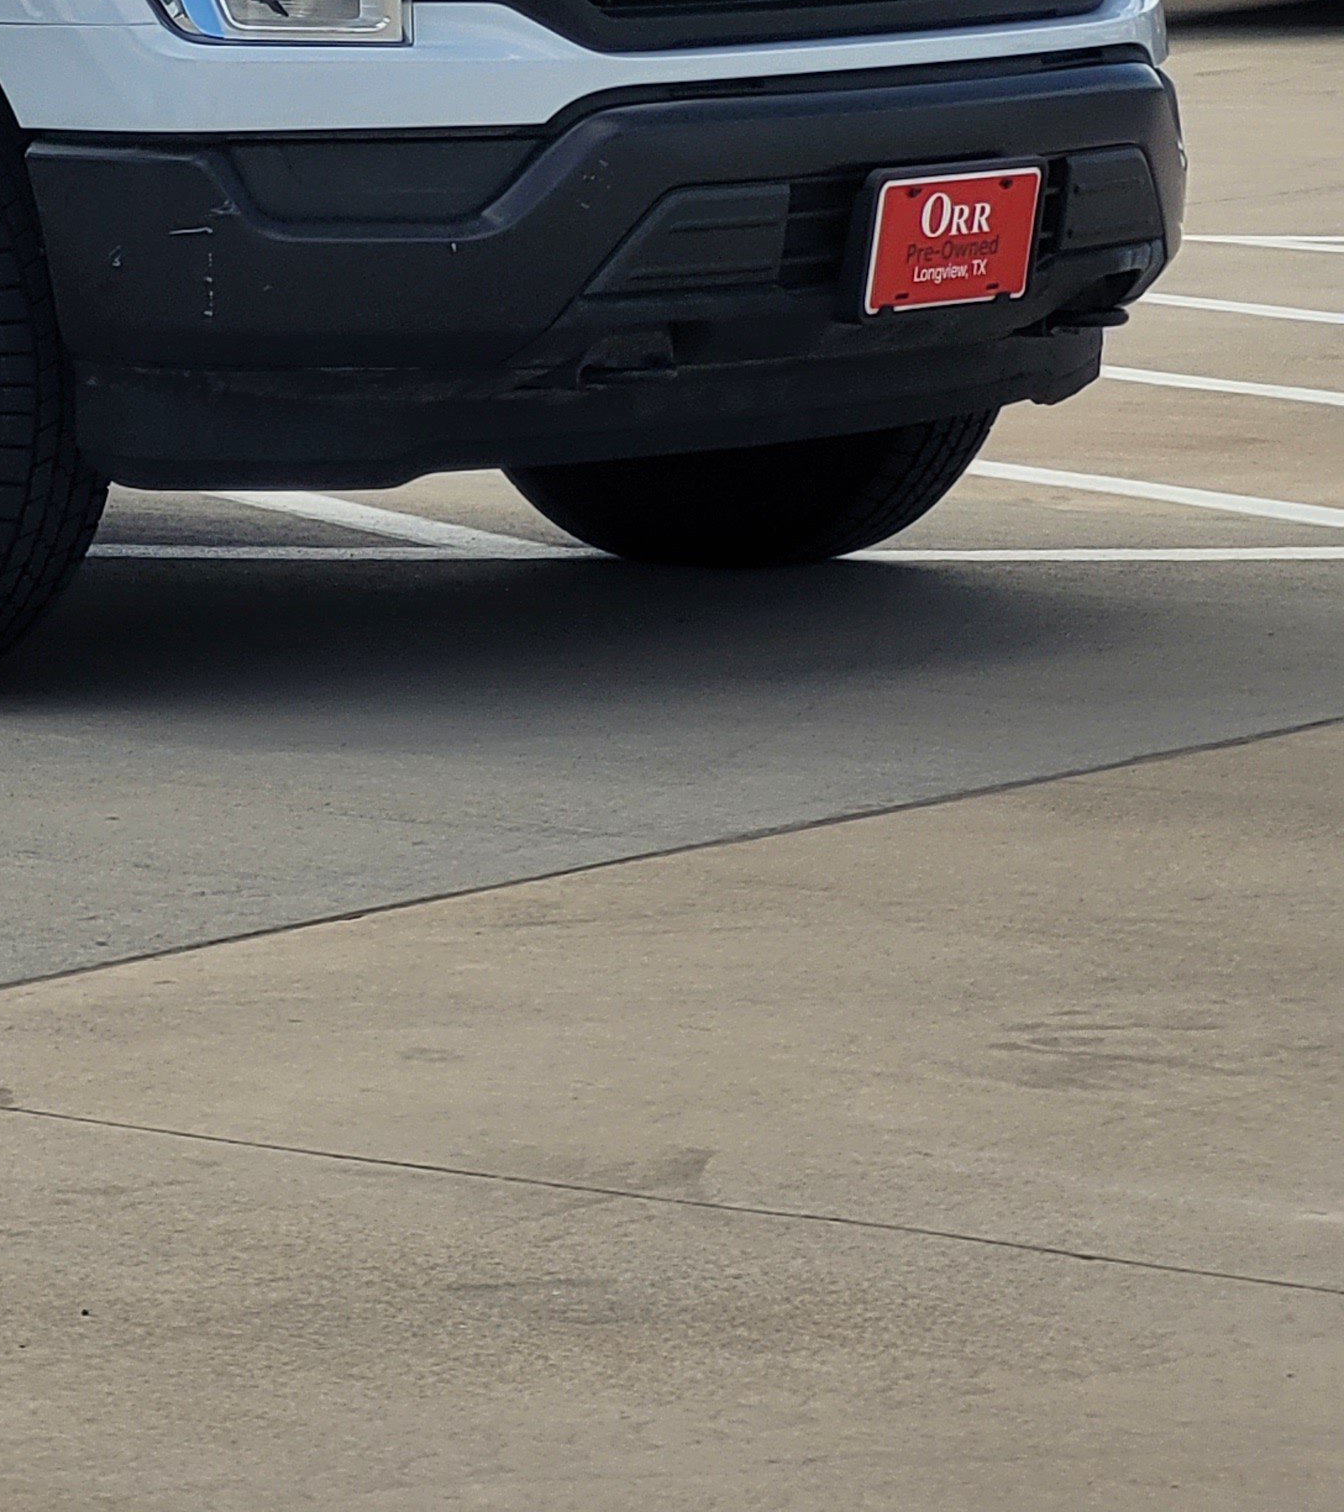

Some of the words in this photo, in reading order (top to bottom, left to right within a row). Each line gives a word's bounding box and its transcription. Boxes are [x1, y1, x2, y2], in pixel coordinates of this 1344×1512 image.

[906, 235, 999, 265] Pre-Owned
[913, 262, 969, 285] Longview,
[972, 259, 988, 276] TX
